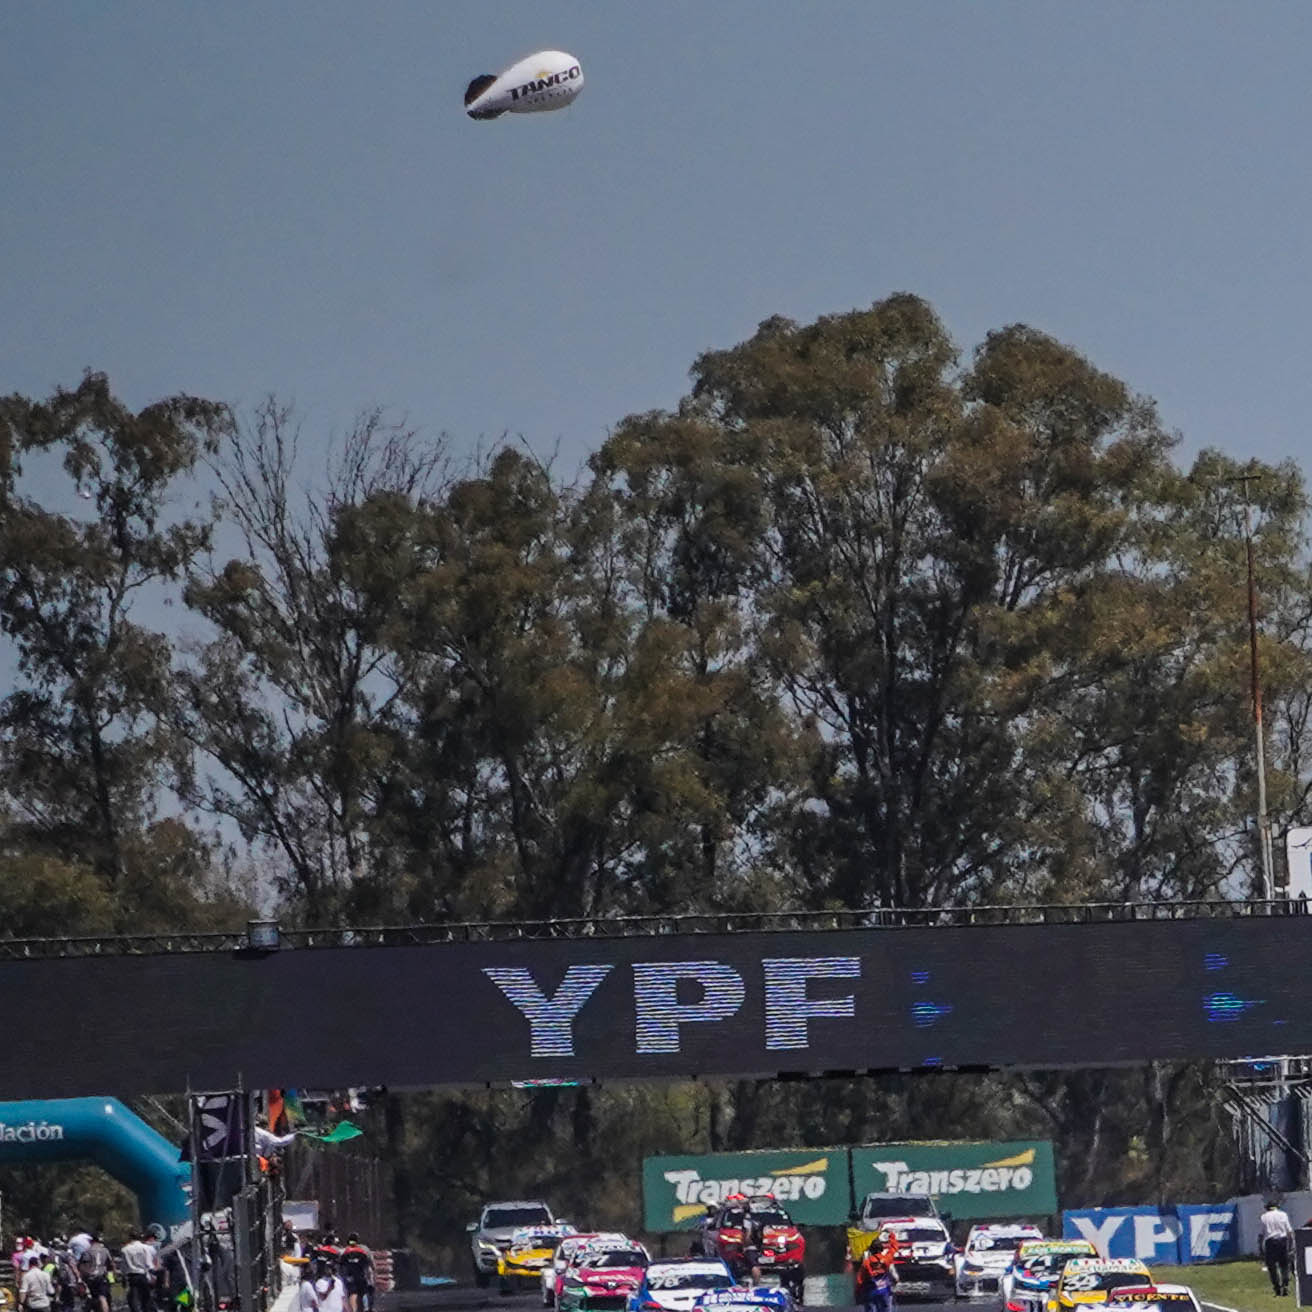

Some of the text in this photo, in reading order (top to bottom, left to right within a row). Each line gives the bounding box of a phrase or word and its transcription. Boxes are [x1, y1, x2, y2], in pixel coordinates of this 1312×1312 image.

[507, 66, 581, 100] TANGO
[482, 957, 862, 1057] YPF
[664, 1170, 826, 1204] Transzero
[873, 1161, 1034, 1195] Transzero
[1071, 1212, 1232, 1259] YPF
[1114, 1294, 1190, 1302] VICENTE
